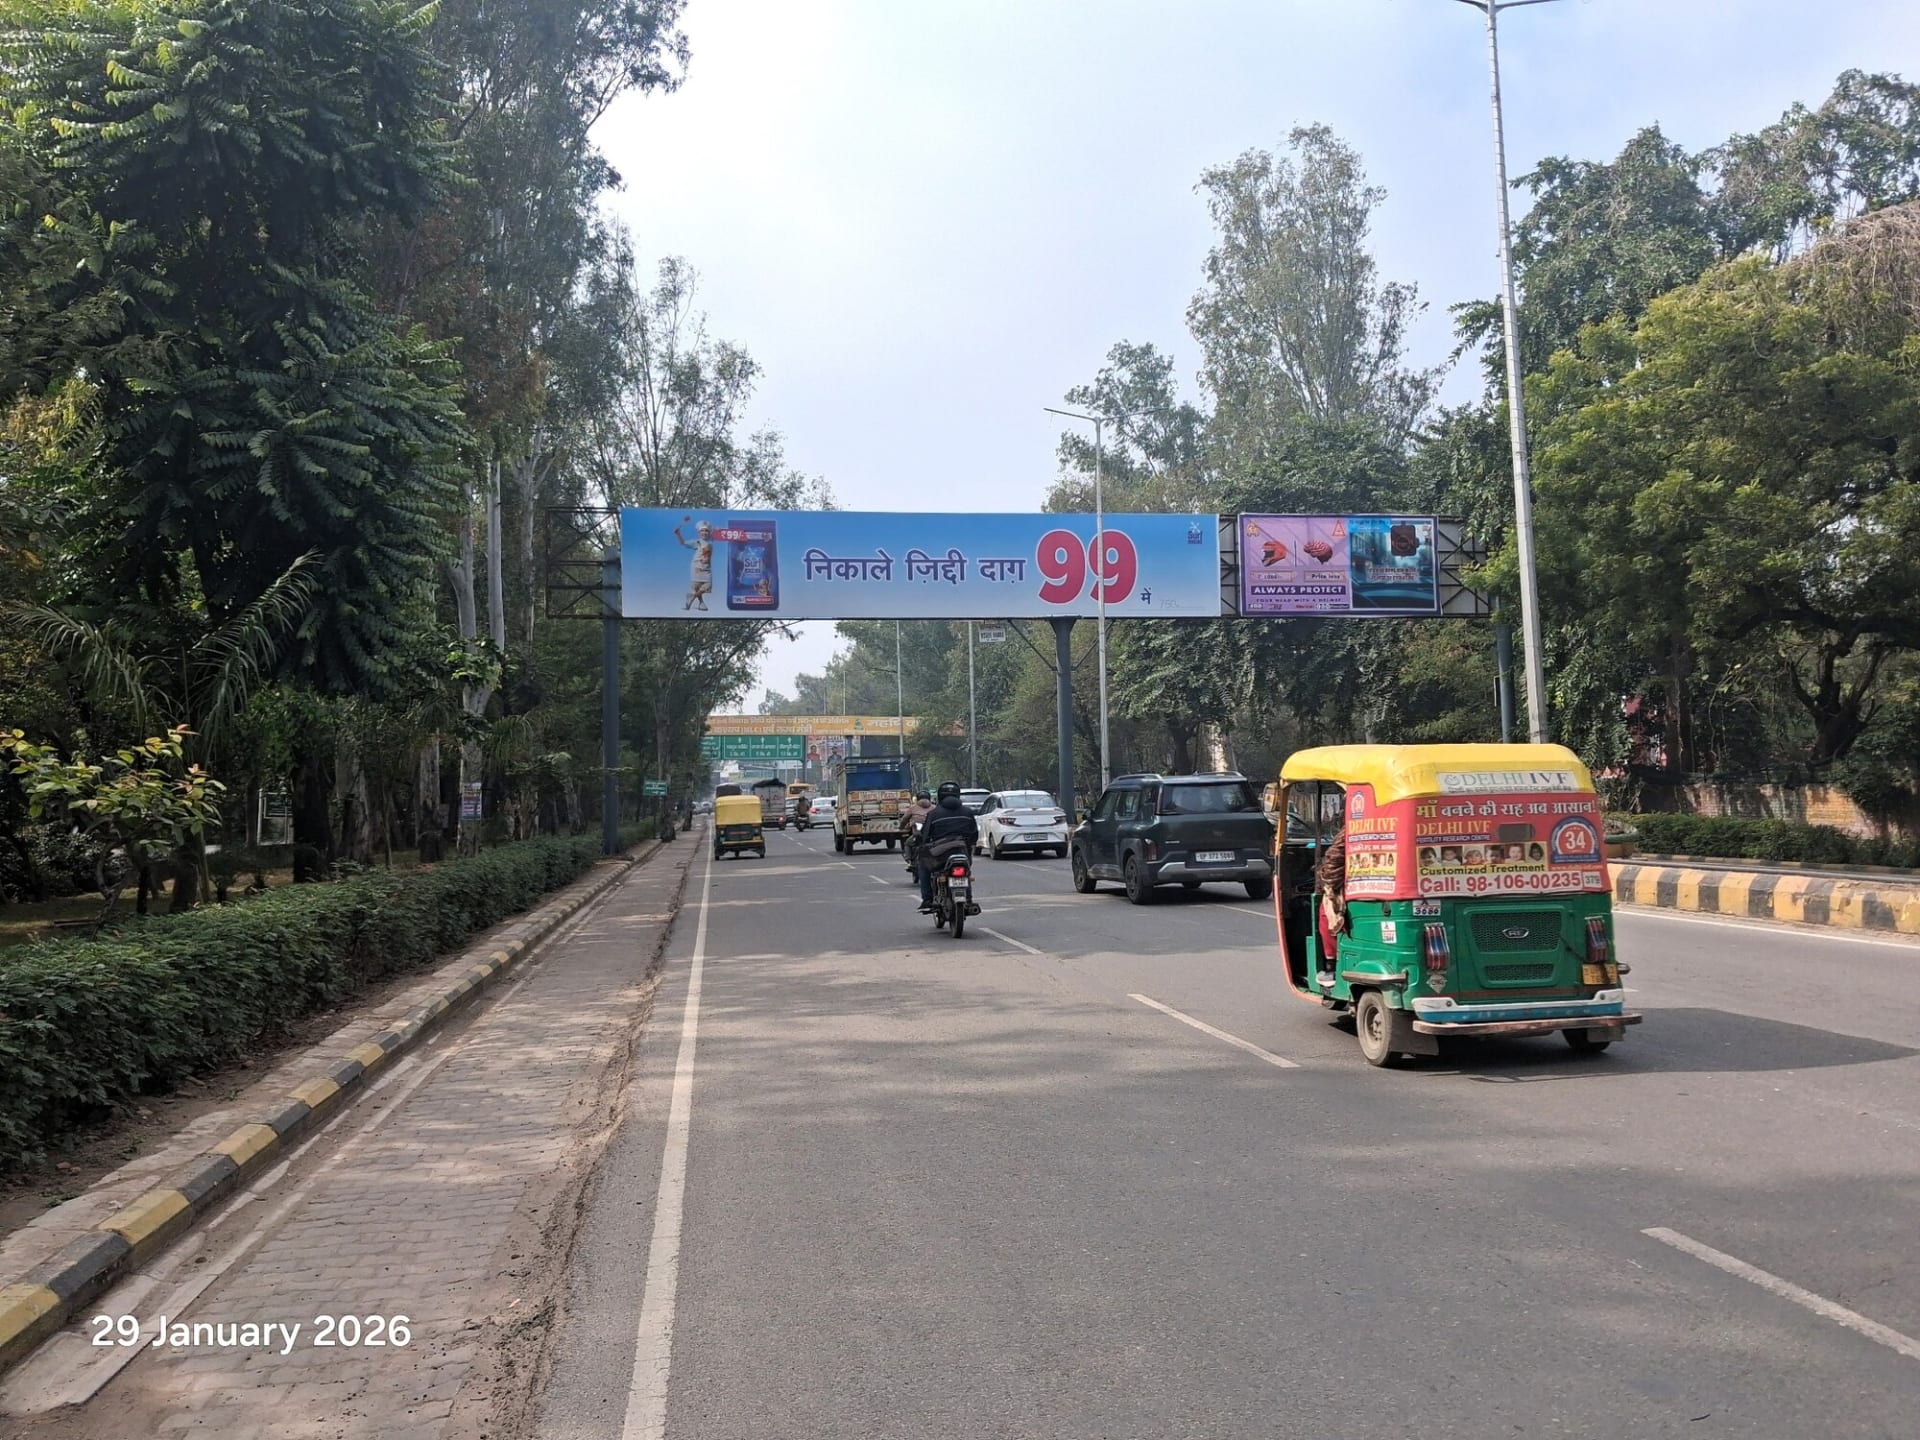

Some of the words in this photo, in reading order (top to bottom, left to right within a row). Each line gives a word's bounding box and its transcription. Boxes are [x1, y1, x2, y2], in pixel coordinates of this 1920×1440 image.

[803, 548, 894, 581] निकाले
[904, 548, 968, 585] ज़िद्दी
[1036, 529, 1138, 605] 99
[1140, 587, 1152, 605] में
[1254, 586, 1296, 594] ALWAYS
[1299, 586, 1342, 594] PROTECT
[1462, 773, 1525, 786] DELHI
[1531, 772, 1568, 785] IVF
[1416, 800, 1438, 818] माँ
[1478, 800, 1497, 816] की
[1500, 803, 1523, 817] राह
[1552, 801, 1597, 814] आसान!
[1349, 819, 1375, 834] DELHI
[1377, 817, 1398, 832] IVF
[1416, 821, 1464, 836] DELHI
[1467, 820, 1492, 834] IVF
[1564, 830, 1586, 850] 34
[1420, 865, 1487, 876] Customized
[1490, 864, 1545, 874] Treatment
[1420, 876, 1461, 893] Call:
[1466, 873, 1581, 892] 98-106-00235
